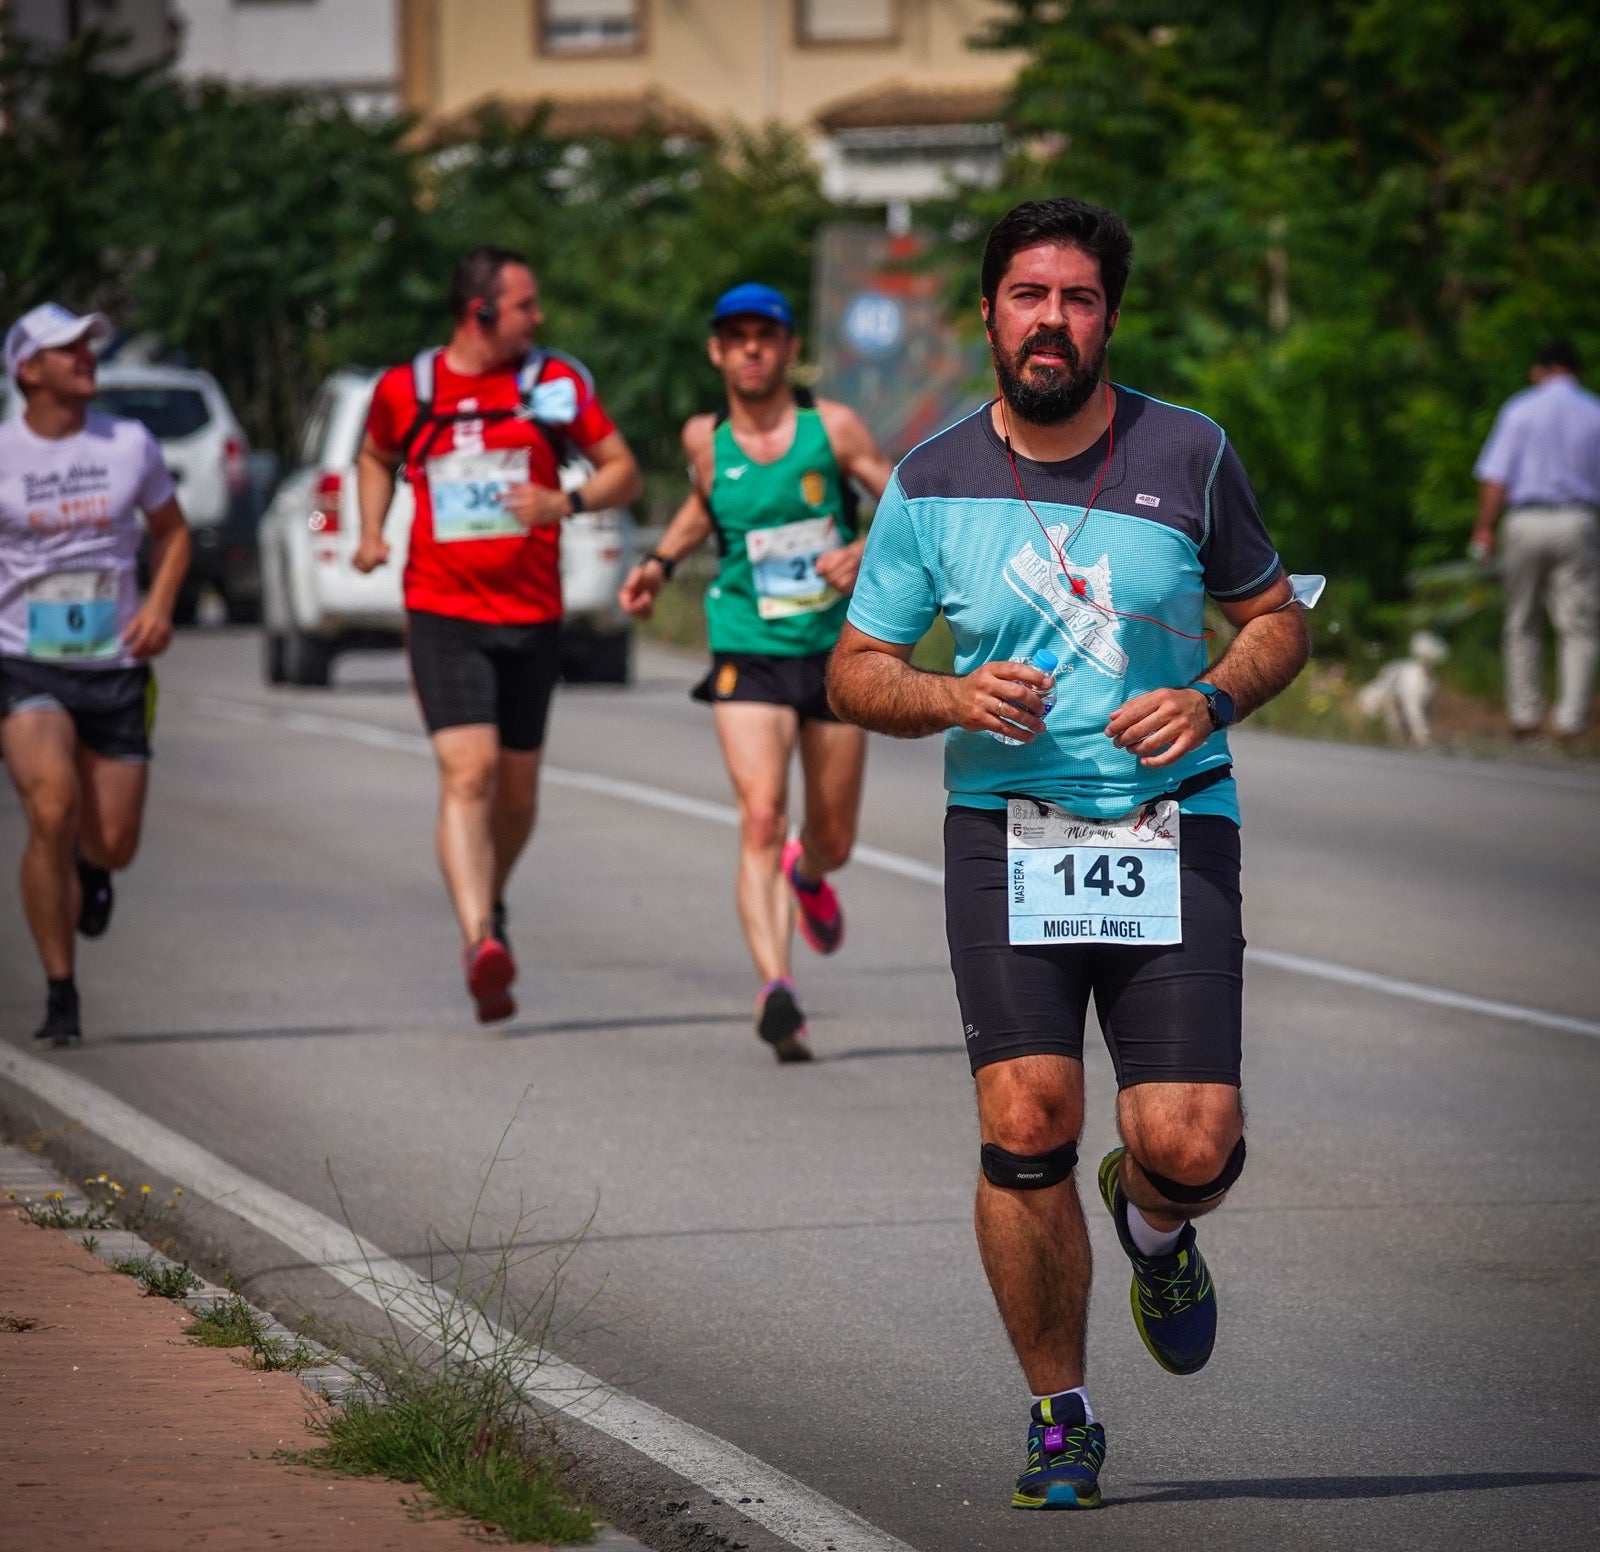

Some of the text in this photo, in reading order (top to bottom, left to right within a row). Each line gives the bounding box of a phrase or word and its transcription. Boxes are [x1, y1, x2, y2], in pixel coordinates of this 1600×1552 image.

[66, 604, 84, 632] 6
[1014, 868, 1025, 904] MASTER
[1054, 854, 1146, 898] 143
[1043, 917, 1145, 938] MIGUEL ÁNGEL
